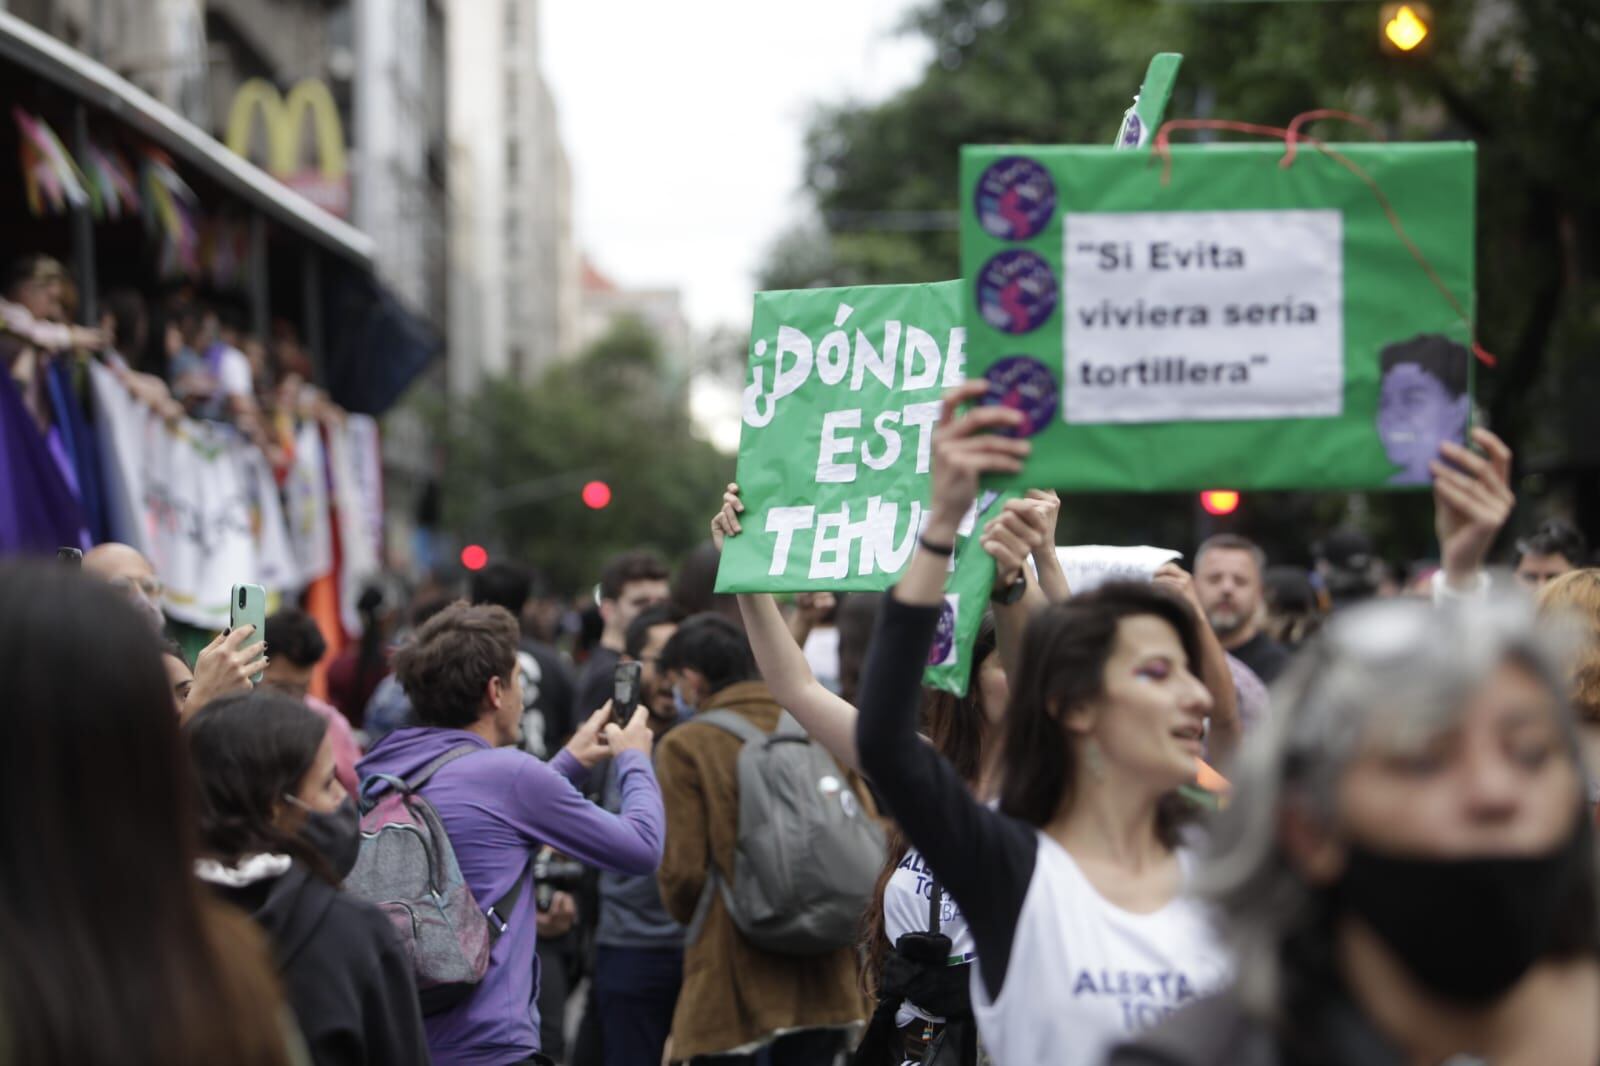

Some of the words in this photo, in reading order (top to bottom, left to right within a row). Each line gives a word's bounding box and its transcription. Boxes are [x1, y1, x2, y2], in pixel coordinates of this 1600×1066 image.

[1078, 242, 1133, 270] "Si
[1149, 241, 1245, 270] Evita
[1080, 299, 1208, 327] viviera
[1224, 294, 1318, 325] sería
[1081, 354, 1268, 386] tortillera"
[815, 400, 942, 483] EST
[765, 496, 978, 580] TEHU
[1072, 969, 1197, 1001] ALERTA
